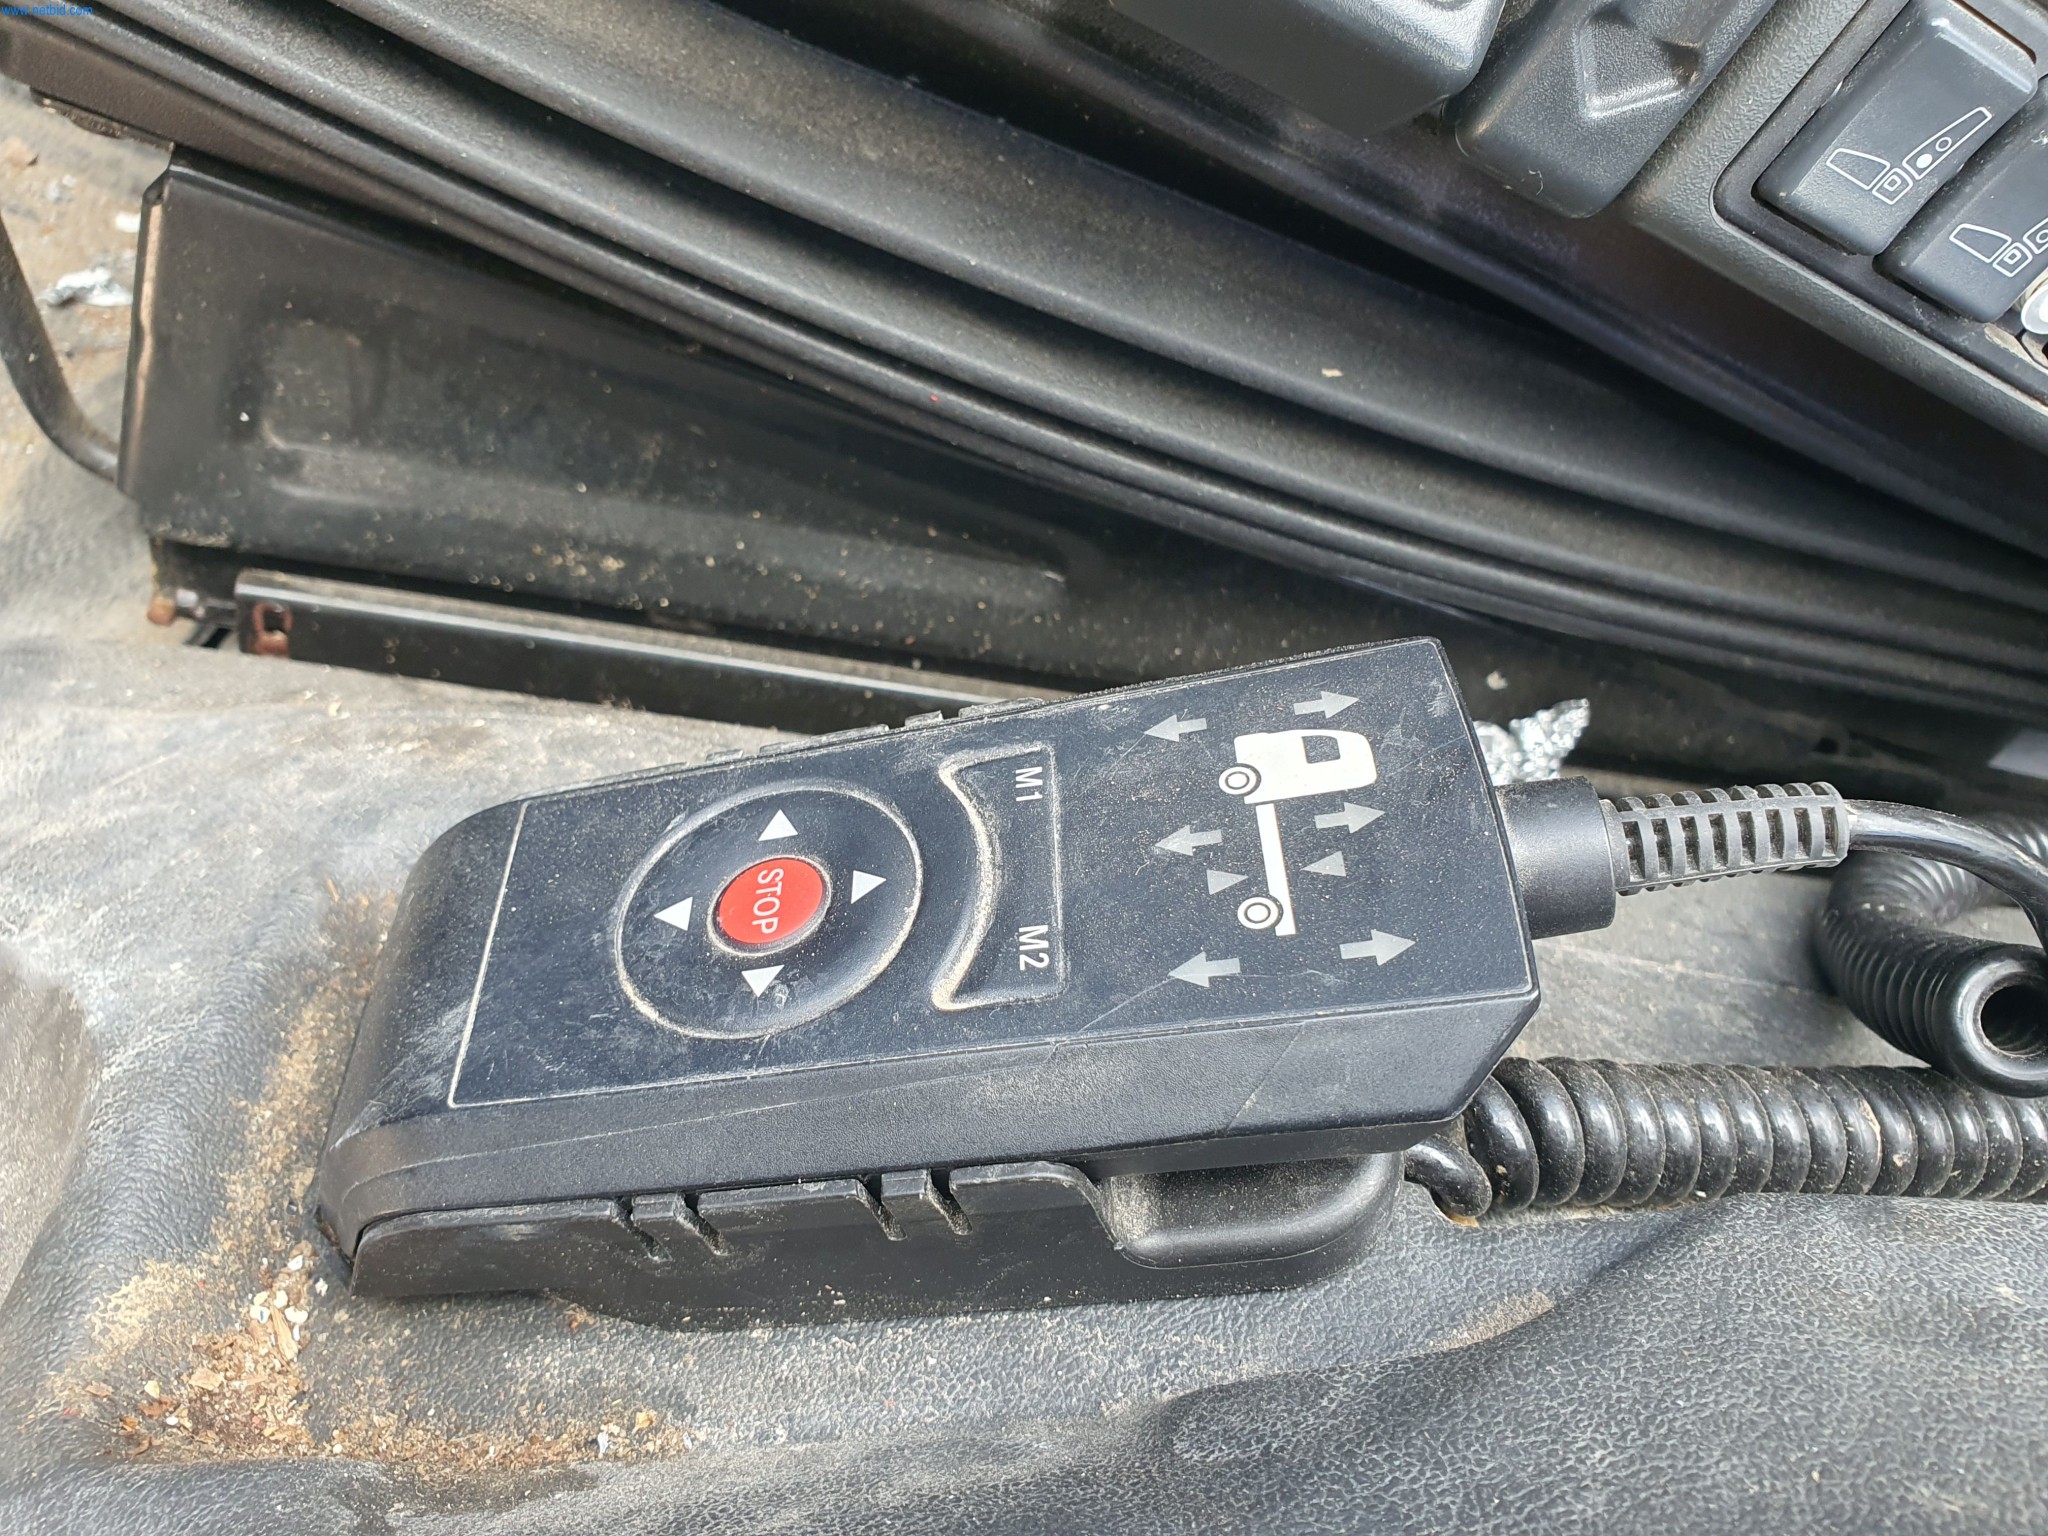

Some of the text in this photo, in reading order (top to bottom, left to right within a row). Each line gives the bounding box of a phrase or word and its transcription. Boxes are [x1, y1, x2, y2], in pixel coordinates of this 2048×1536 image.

[1015, 766, 1043, 801] M1
[751, 867, 784, 934] STOP
[1018, 924, 1050, 971] M2
